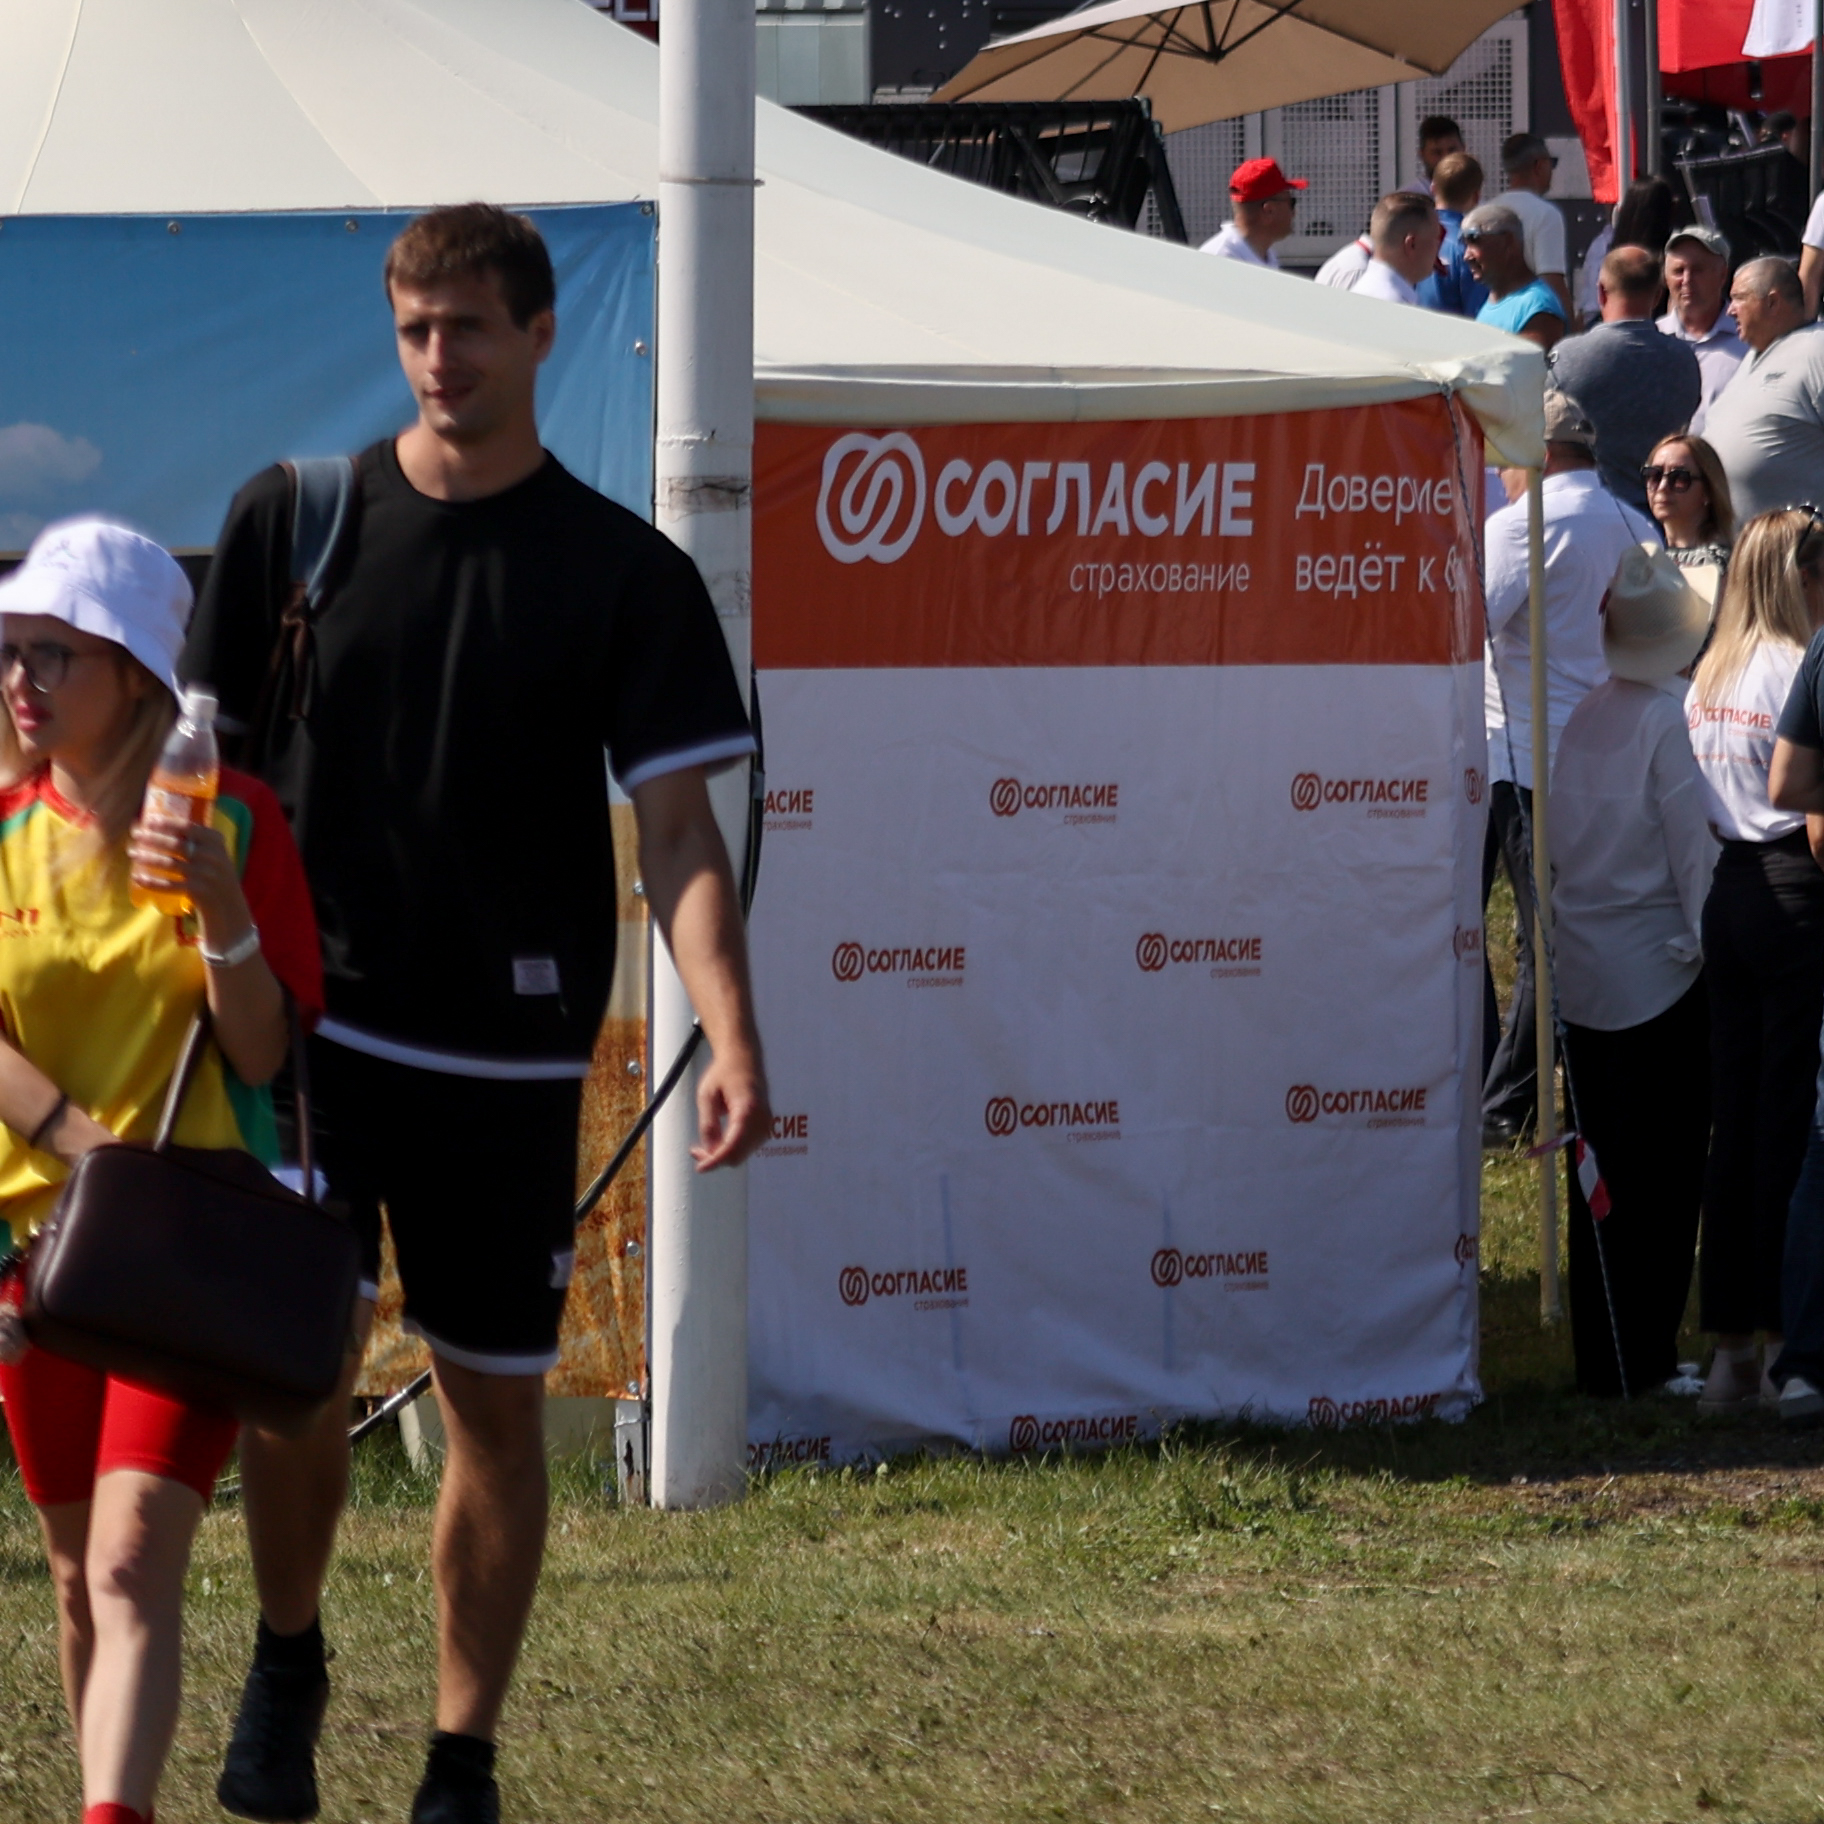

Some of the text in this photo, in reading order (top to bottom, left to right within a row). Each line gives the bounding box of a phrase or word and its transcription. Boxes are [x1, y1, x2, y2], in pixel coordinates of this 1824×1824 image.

[933, 460, 1456, 538] СОГЛАСИЕ Доверие
[1070, 558, 1251, 598] страхование
[1295, 548, 1404, 601] ведёт
[1022, 783, 1119, 810] СОГЛАСИЕ
[1323, 778, 1428, 805] СОГЛАСИЕ
[866, 946, 966, 974] СОГЛАСИЕ
[1169, 937, 1263, 965] СОГЛАСИЕ
[1020, 1100, 1120, 1128] СОГЛАСИЕ
[1323, 1088, 1428, 1115] СОГЛАСИЕ
[1184, 1250, 1269, 1279] СОГЛАСИЕ
[871, 1268, 968, 1296] СОГЛАСИЕ
[1041, 1416, 1138, 1445] СОГЛАСИЕ
